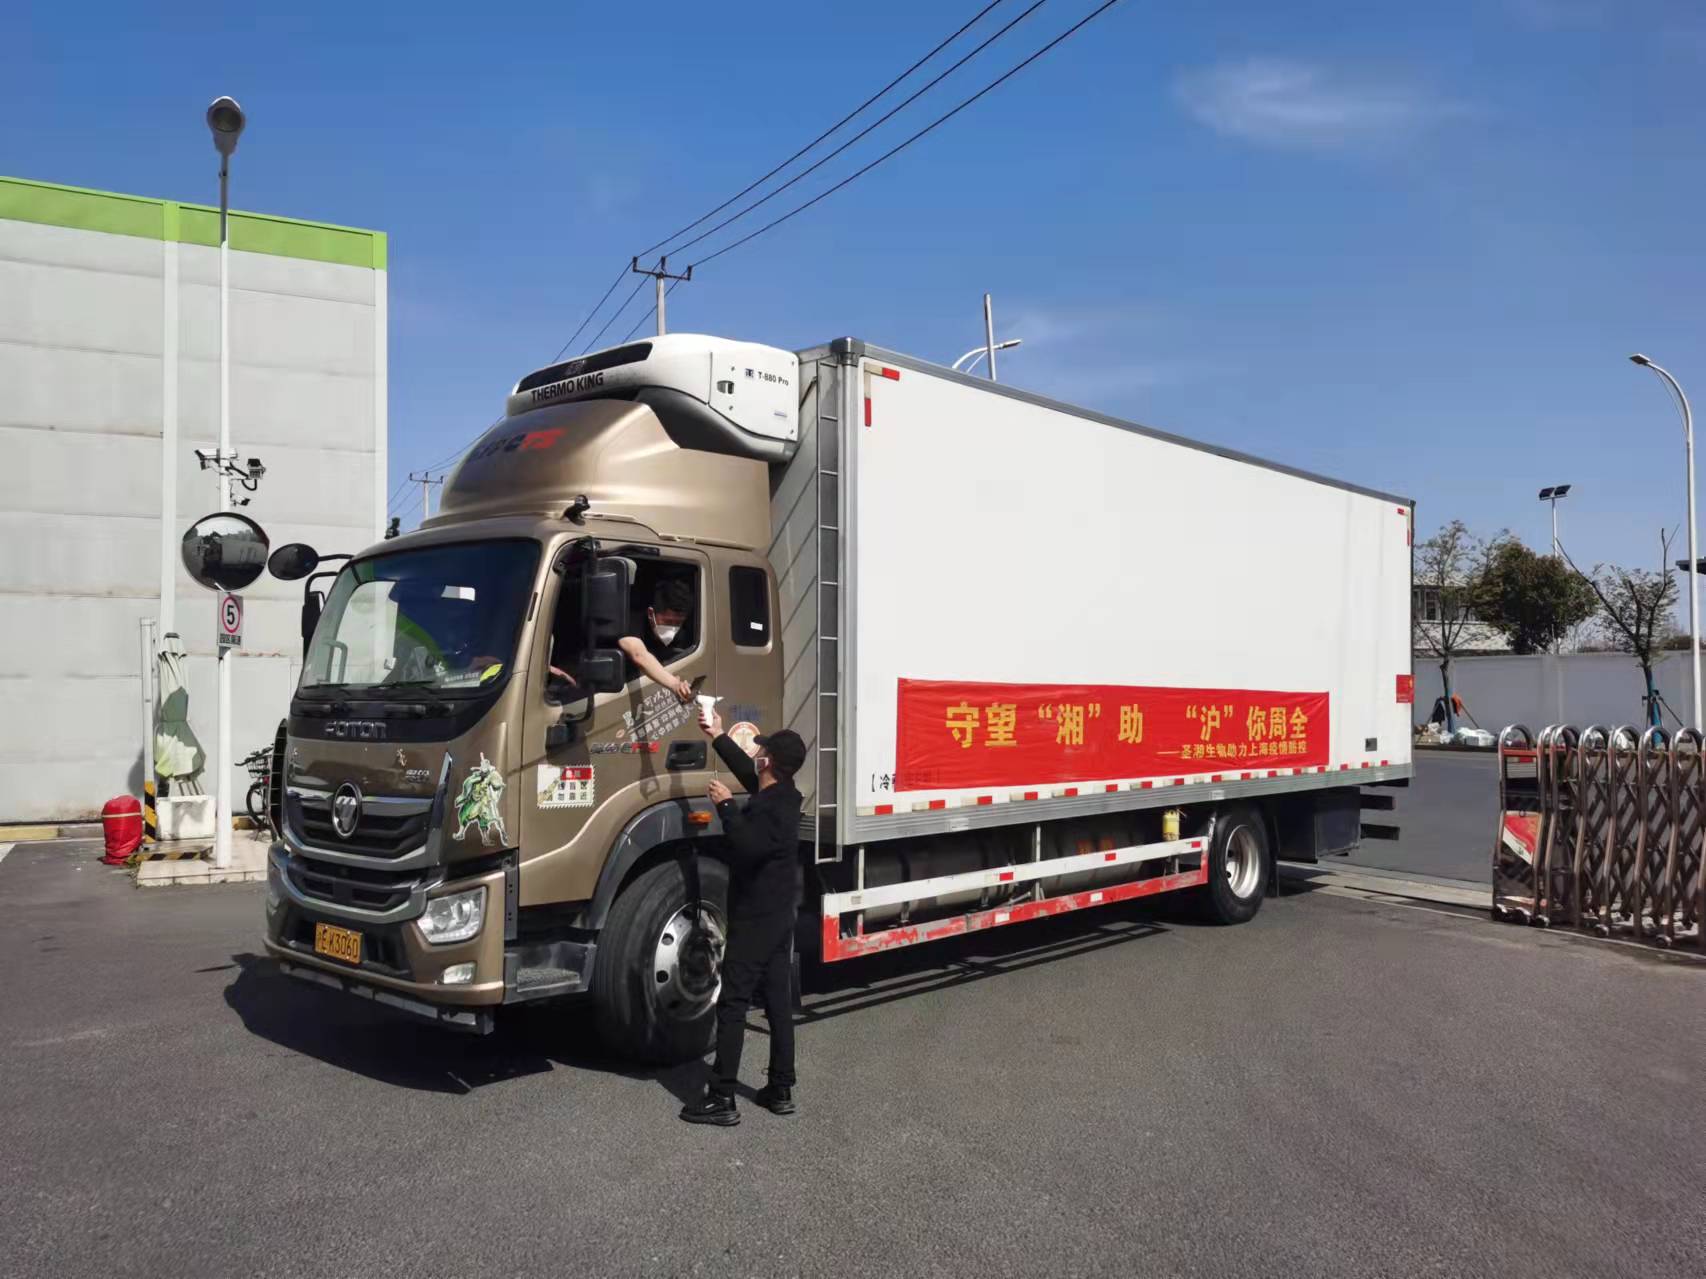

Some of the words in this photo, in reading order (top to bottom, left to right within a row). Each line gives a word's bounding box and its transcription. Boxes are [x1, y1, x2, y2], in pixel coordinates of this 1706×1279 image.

[531, 380, 575, 402] THERMO
[577, 372, 604, 391] KING
[778, 376, 789, 386] Pro
[226, 604, 235, 625] 5
